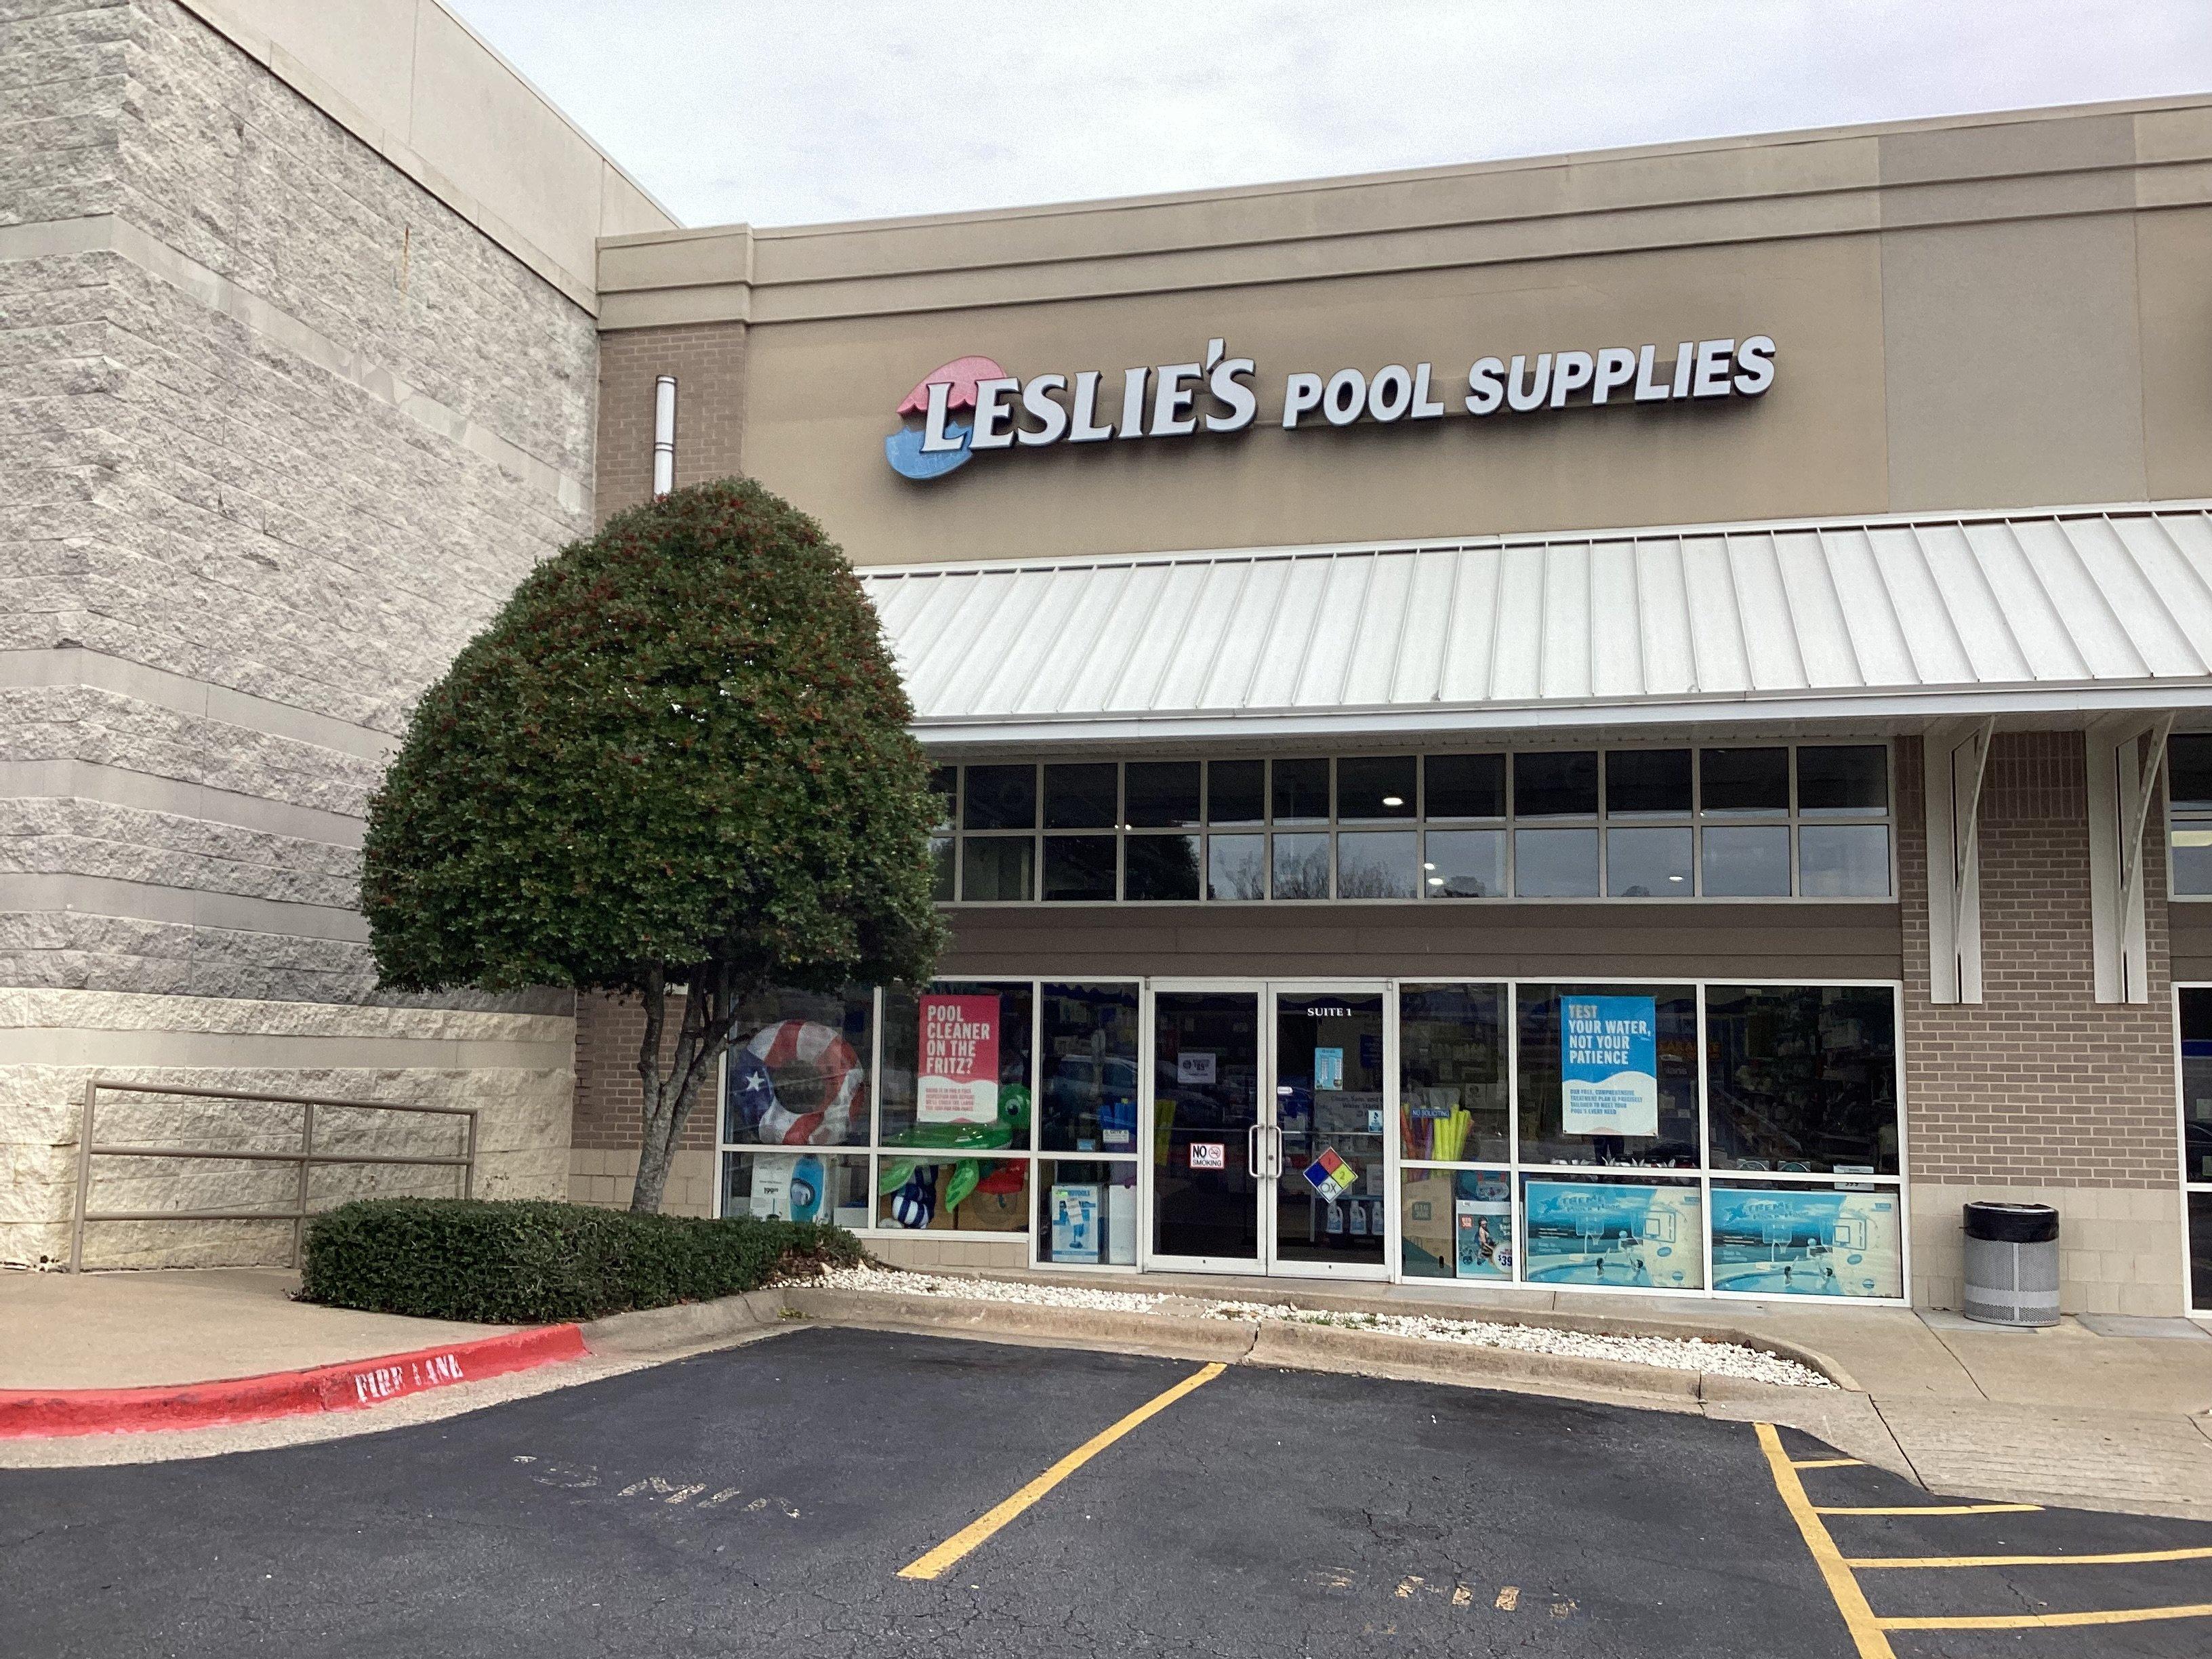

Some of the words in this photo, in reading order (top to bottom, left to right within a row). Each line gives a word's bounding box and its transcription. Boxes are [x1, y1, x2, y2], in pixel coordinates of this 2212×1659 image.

[920, 337, 1256, 453] LESLIE'S
[1282, 361, 1445, 430] POOL
[1465, 335, 1776, 415] SUPPLIES
[928, 1005, 964, 1022] POOL
[1307, 1008, 1343, 1017] SUITE
[1346, 1008, 1352, 1017] 1
[1568, 1004, 1598, 1019] TEST
[927, 1022, 990, 1040] CLEANER
[1568, 1019, 1602, 1034] YOUR
[1605, 1020, 1652, 1037] WATER,
[926, 1039, 945, 1057] ON
[950, 1040, 976, 1057] THE
[1570, 1035, 1593, 1049] NOT
[1596, 1035, 1630, 1050] YOUR
[1570, 1050, 1629, 1065] PATIENCE
[926, 1057, 974, 1074] FRITZ?
[1193, 1145, 1207, 1158] NO
[1339, 1171, 1345, 1180] 2
[1320, 1183, 1337, 1194] OX
